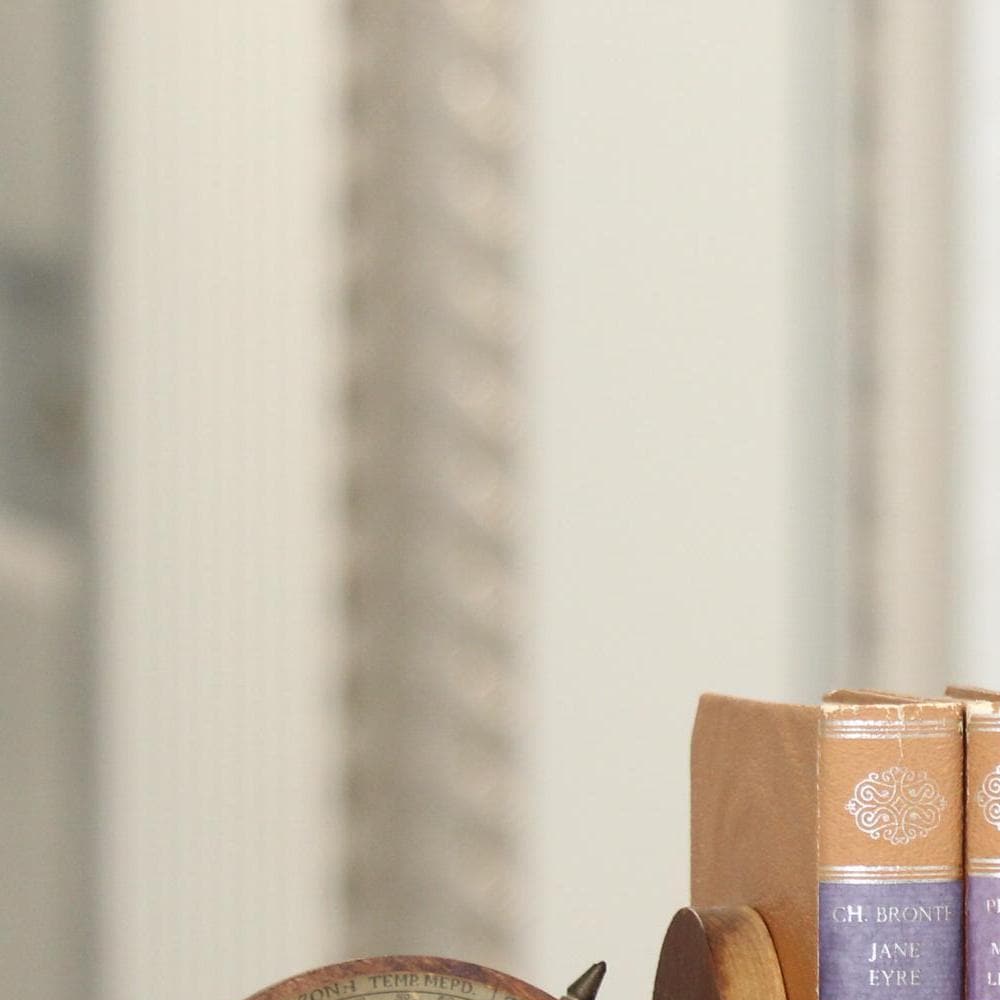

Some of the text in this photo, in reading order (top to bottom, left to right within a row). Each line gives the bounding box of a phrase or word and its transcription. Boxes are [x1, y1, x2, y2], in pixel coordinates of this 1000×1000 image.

[832, 905, 868, 923] CH.
[868, 942, 920, 962] JANE
[869, 969, 921, 986] EYRE
